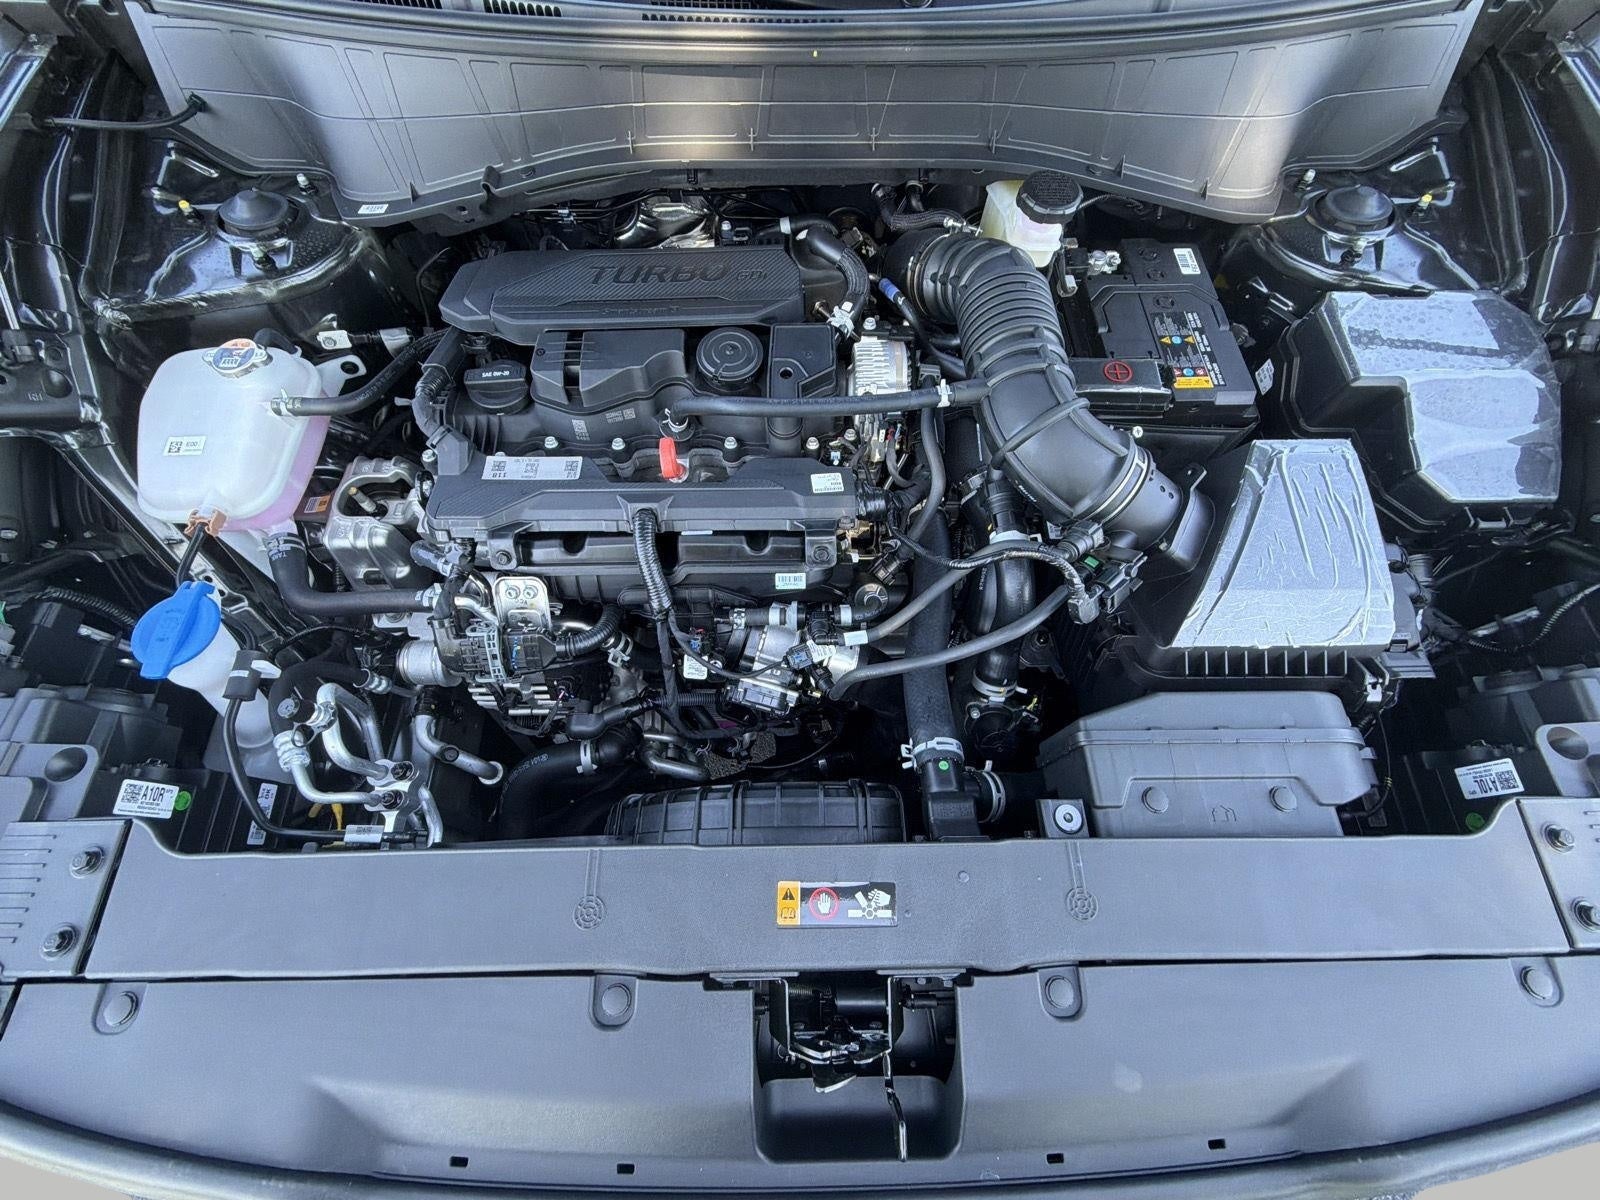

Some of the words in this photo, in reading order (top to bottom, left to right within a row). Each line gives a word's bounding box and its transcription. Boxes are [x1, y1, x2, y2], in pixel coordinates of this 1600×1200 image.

[591, 264, 731, 284] TURBO
[141, 785, 166, 802] A10R
[1473, 776, 1499, 795] A10L
